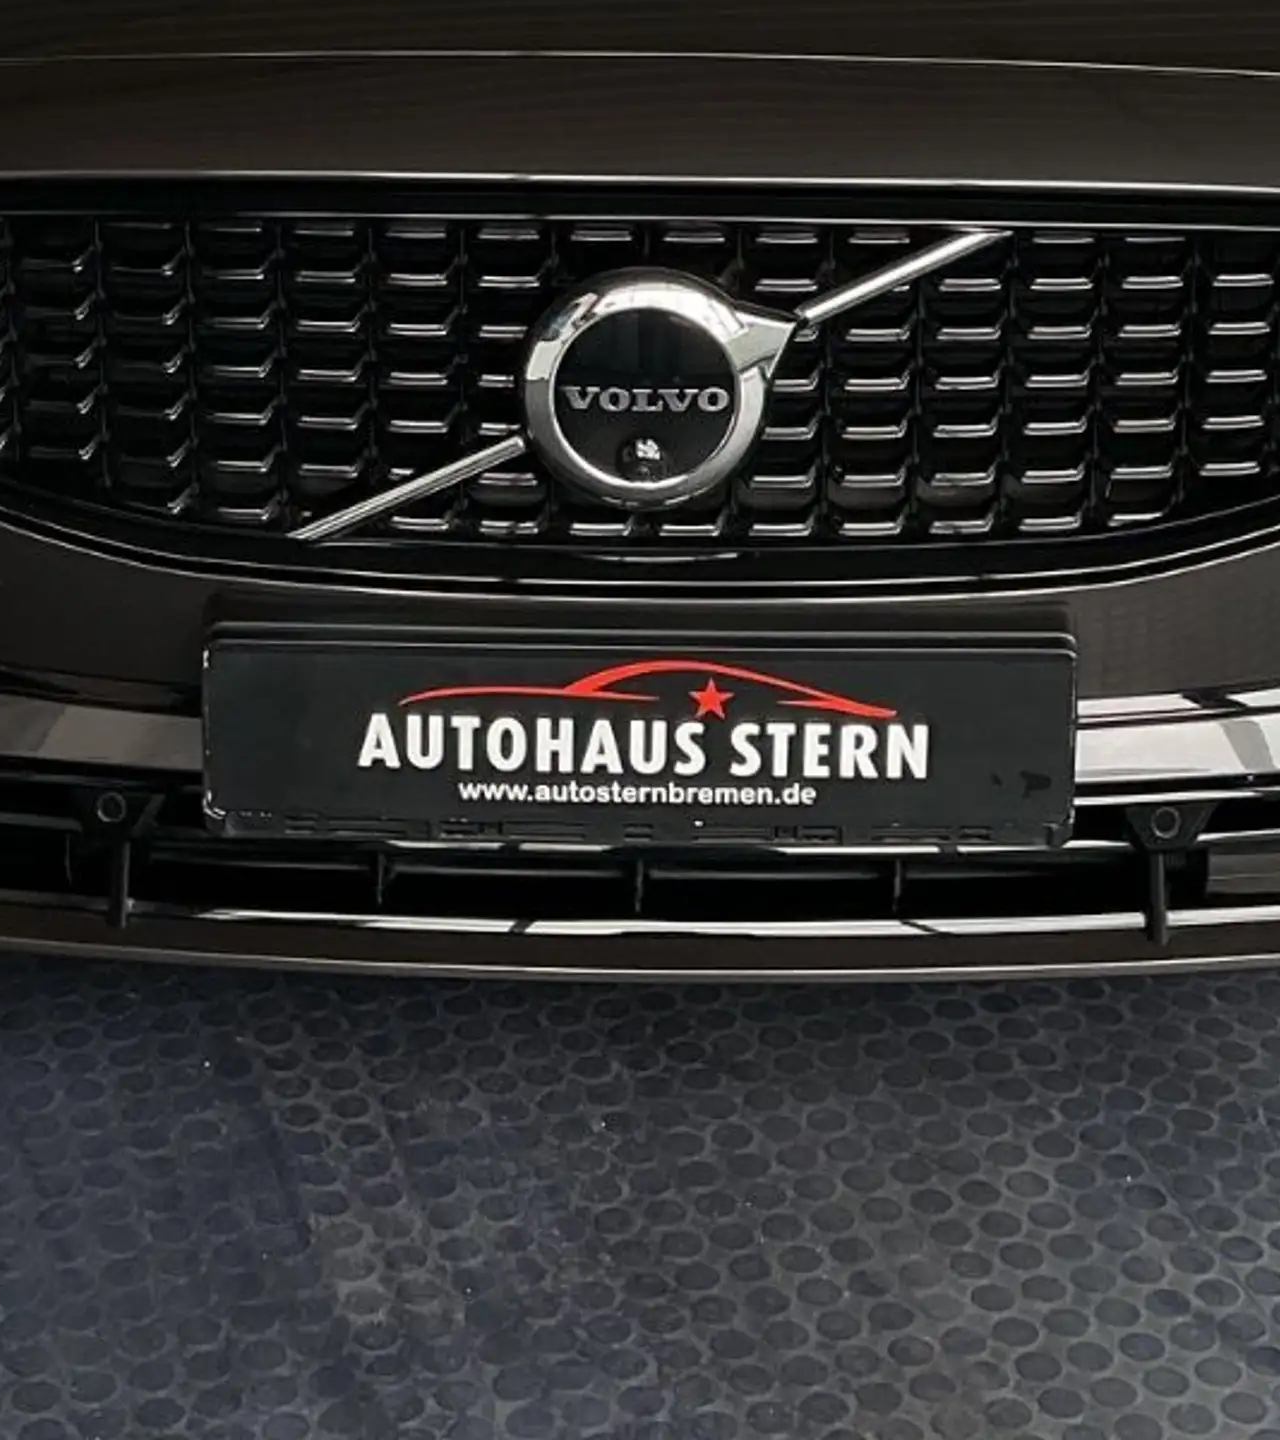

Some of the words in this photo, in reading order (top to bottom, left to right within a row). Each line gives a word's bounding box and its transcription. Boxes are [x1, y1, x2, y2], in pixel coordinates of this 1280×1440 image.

[560, 386, 730, 412] VOLVO
[358, 713, 706, 776] AUTOHAUS
[729, 721, 929, 779] STERN
[458, 780, 817, 805] www.autosternbremen.de
